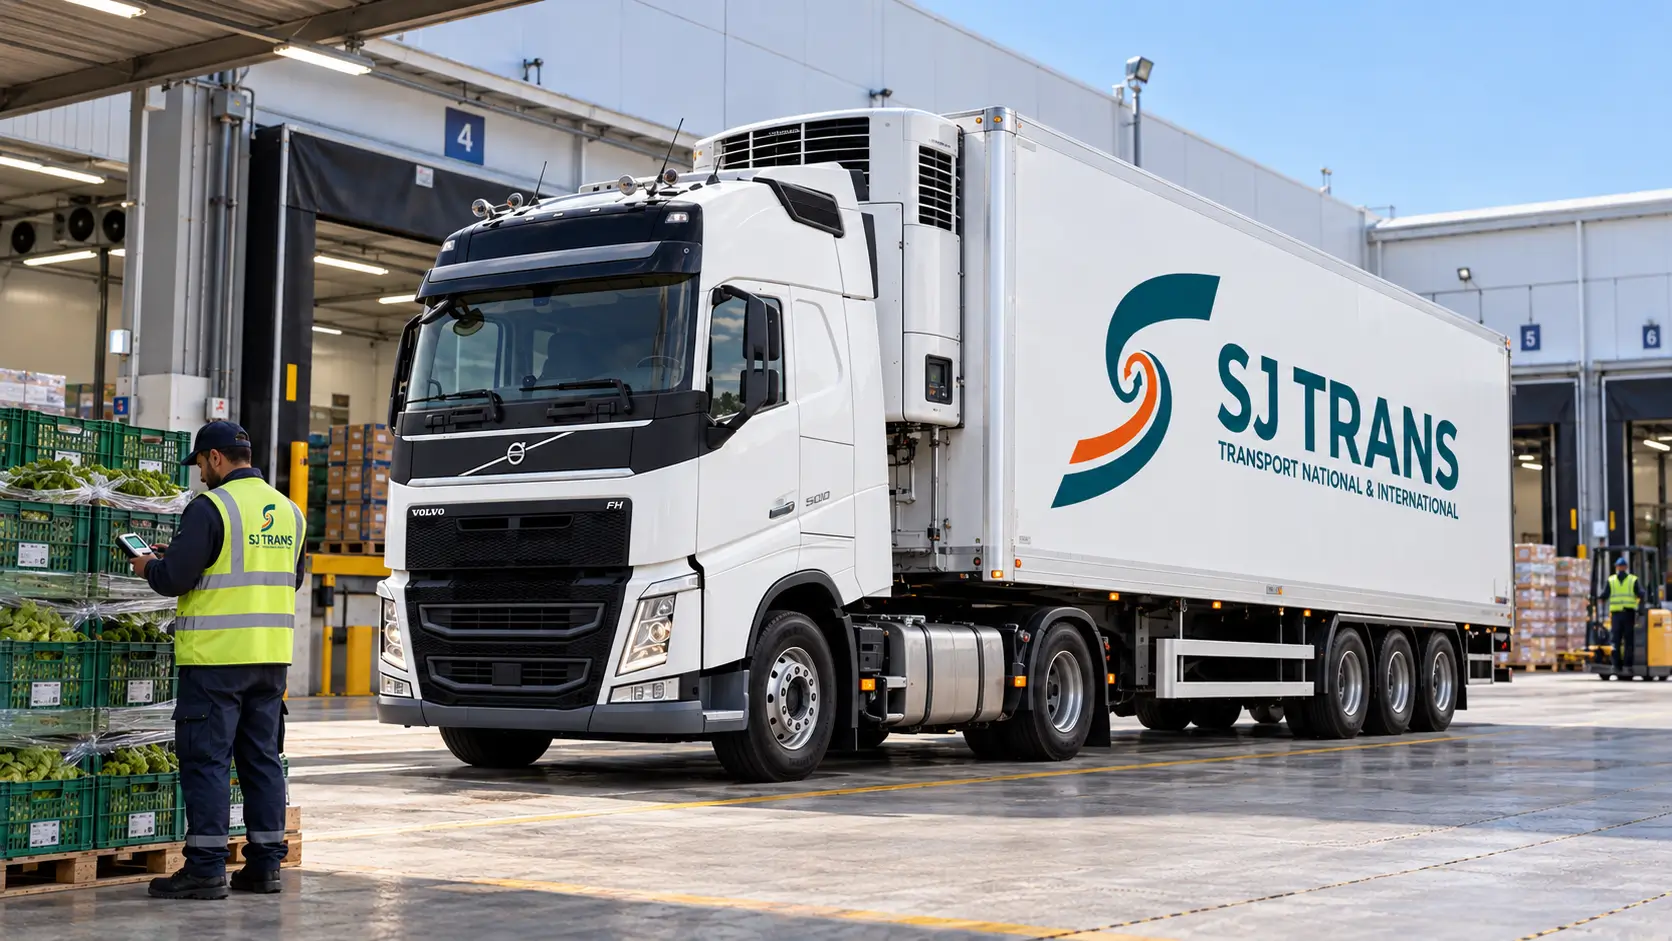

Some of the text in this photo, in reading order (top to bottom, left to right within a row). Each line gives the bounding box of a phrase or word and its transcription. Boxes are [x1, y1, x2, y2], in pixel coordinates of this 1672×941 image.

[457, 123, 473, 152] 4
[1526, 331, 1536, 347] 5
[1646, 330, 1657, 346] 6
[1217, 343, 1459, 492] SJ TRANS
[1218, 439, 1459, 520] TRANSPORT NATIONAL & INTERNATIONAL
[412, 508, 445, 517] VOLVO
[606, 501, 624, 510] FH
[248, 534, 293, 546] SJ TRANS
